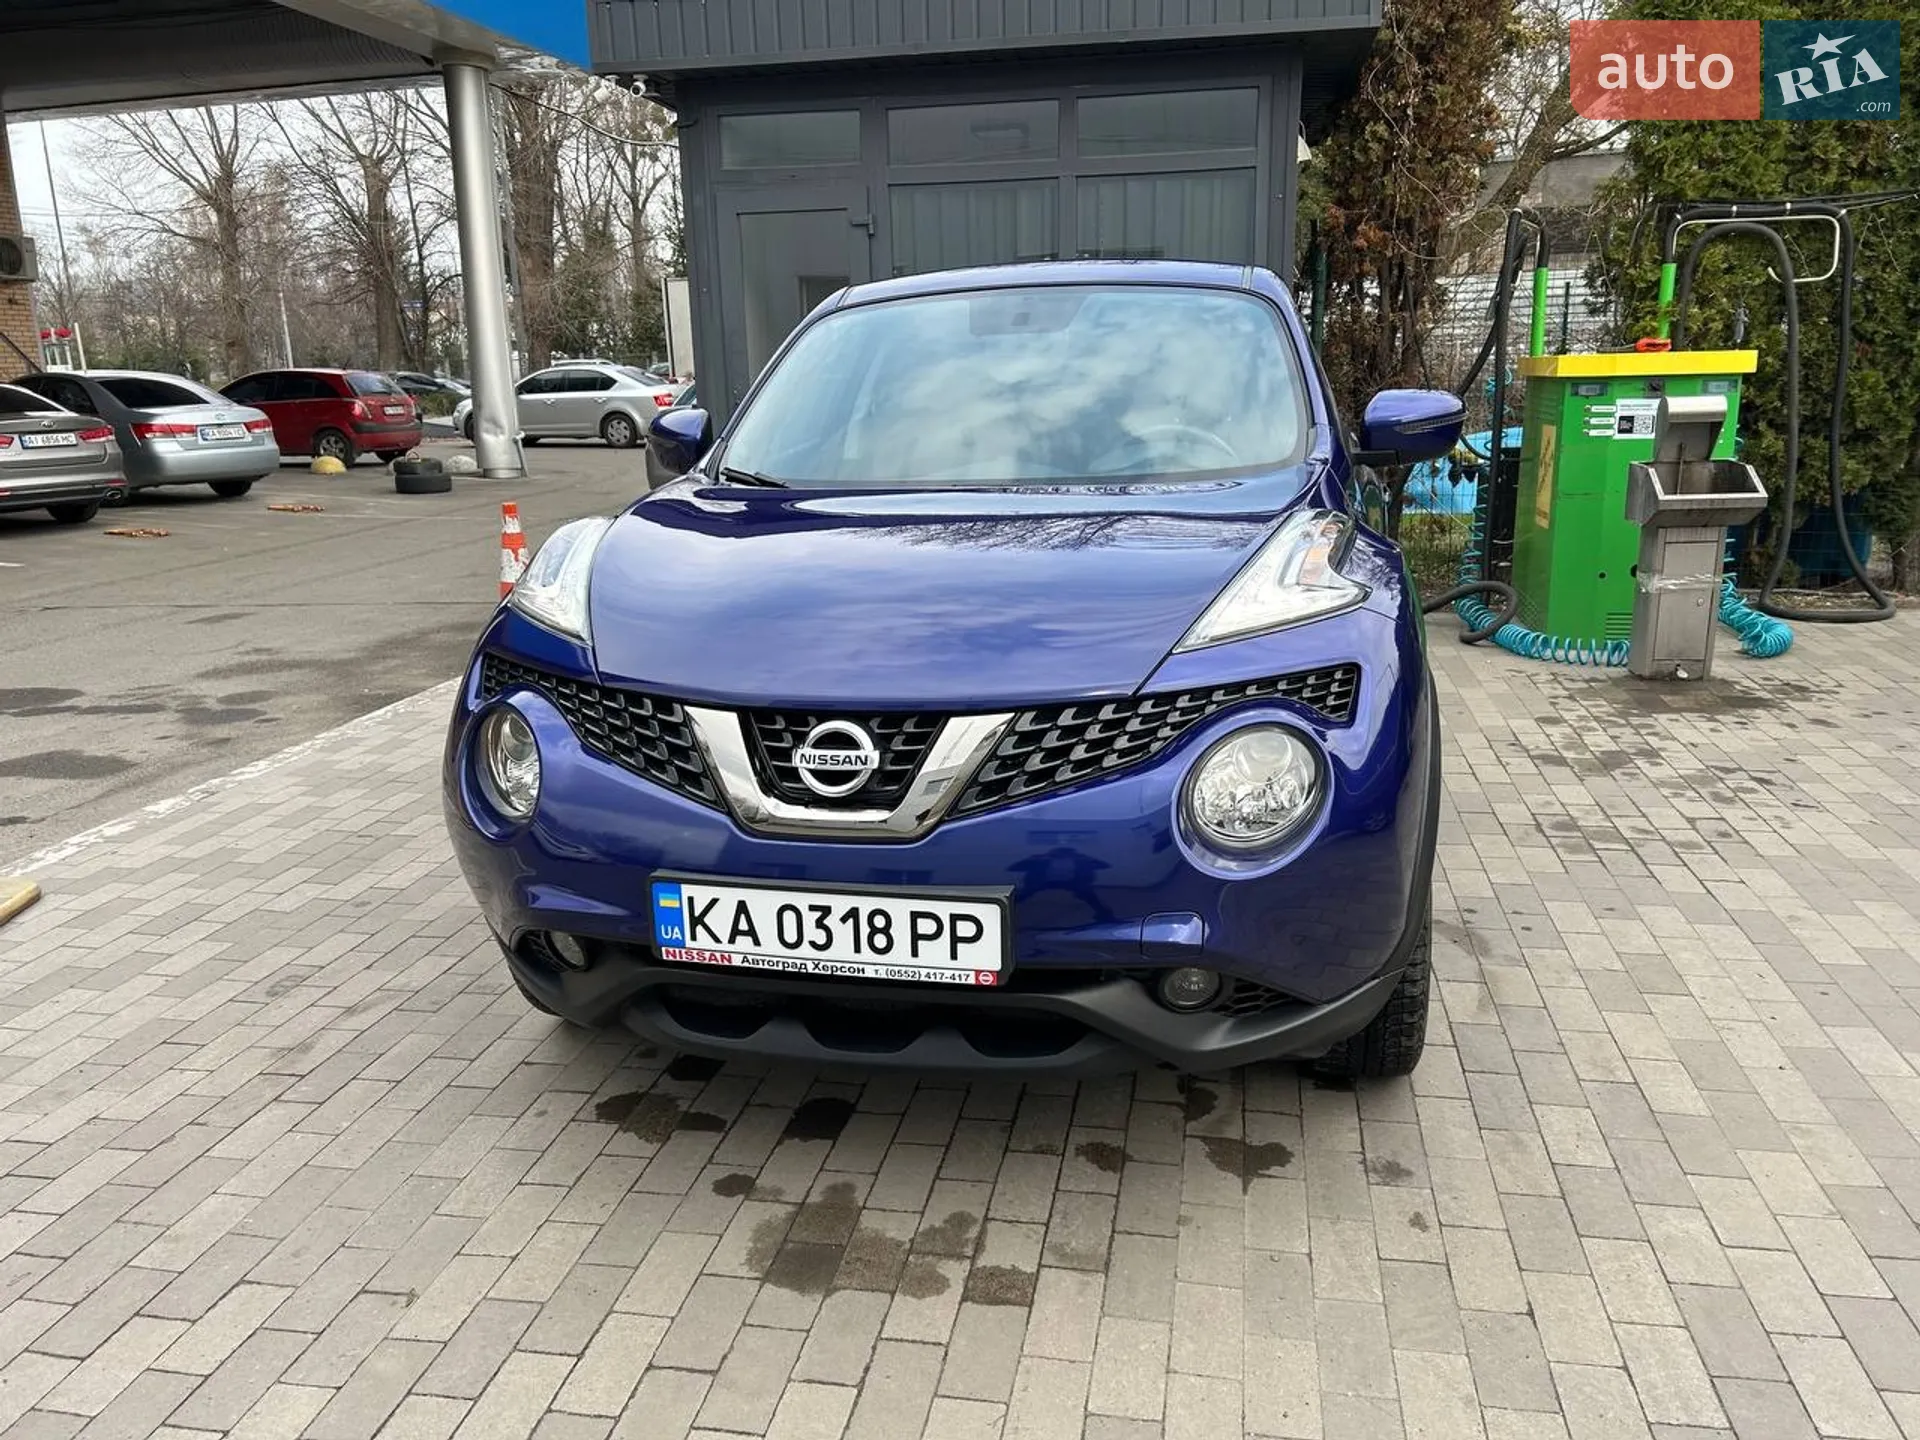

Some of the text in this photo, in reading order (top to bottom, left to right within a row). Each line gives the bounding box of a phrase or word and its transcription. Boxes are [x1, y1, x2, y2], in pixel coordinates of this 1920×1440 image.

[799, 753, 869, 766] NISSAN
[661, 924, 682, 941] UA
[686, 895, 985, 961] KA 0318 PP
[664, 948, 733, 965] NISSAN
[740, 955, 808, 973] Автоград
[811, 961, 866, 975] Херсон
[884, 968, 922, 981] (0552)
[924, 971, 971, 983] 417-417
